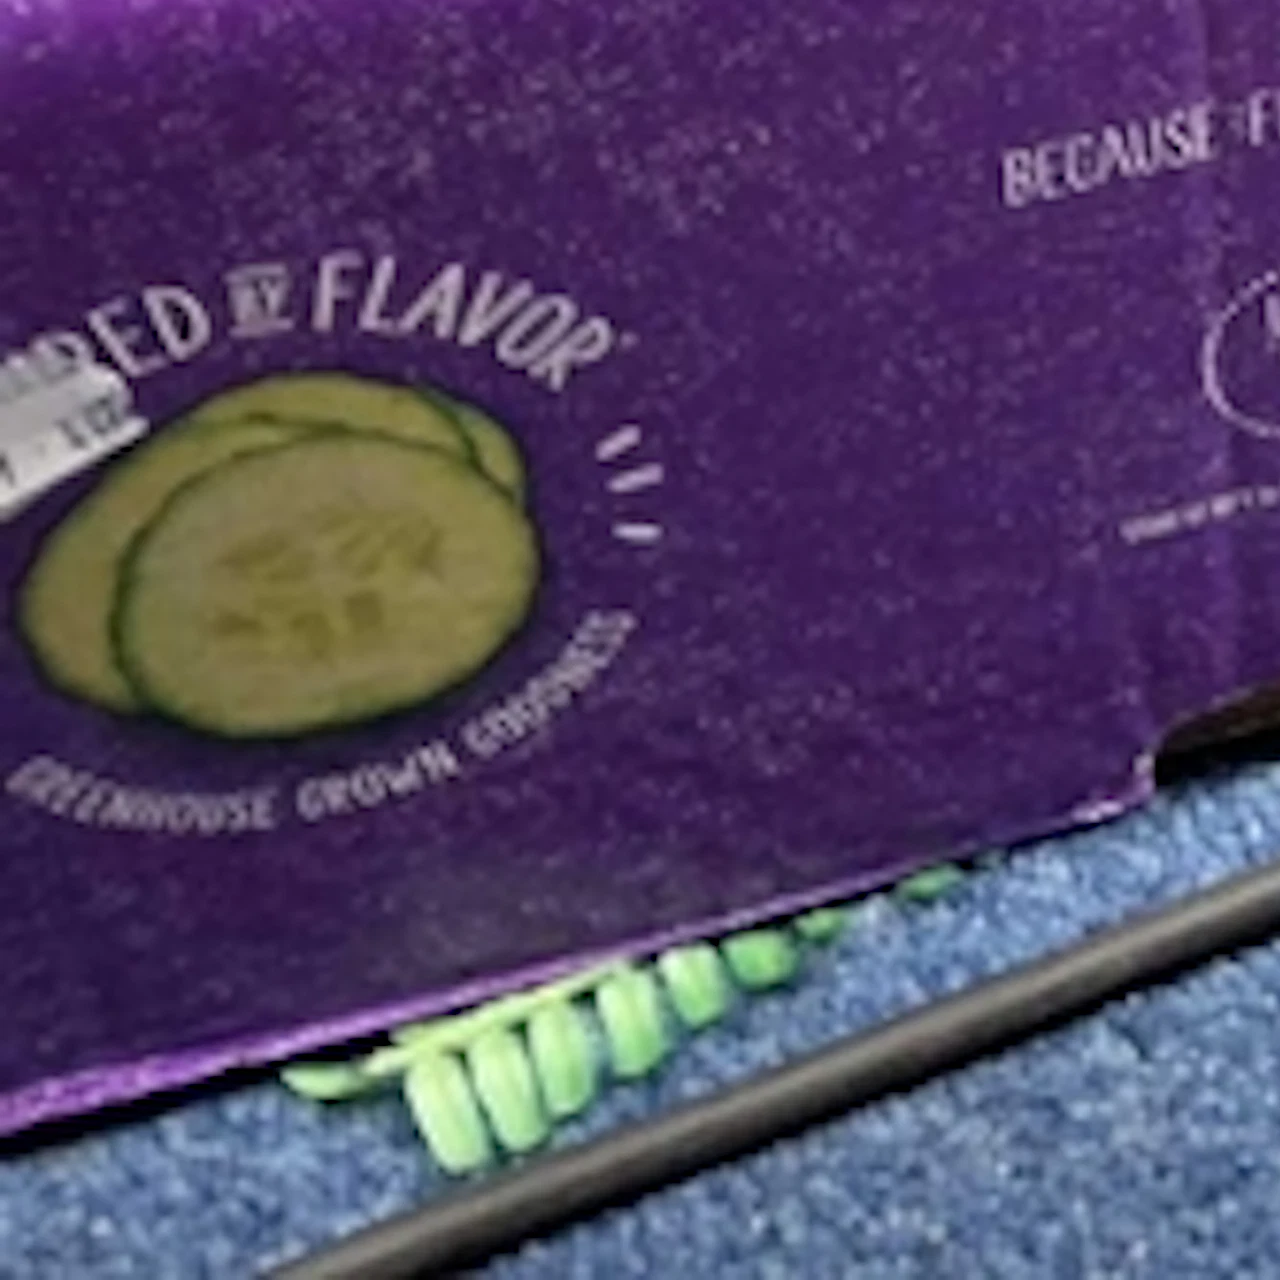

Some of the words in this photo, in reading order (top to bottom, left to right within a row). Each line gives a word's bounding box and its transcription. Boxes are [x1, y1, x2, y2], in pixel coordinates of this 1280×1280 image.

[1000, 97, 1213, 208] BECAUSE
[312, 250, 612, 392] FLAVOR
[5, 754, 280, 837] GREENHOUSE
[296, 739, 461, 824] GROWN
